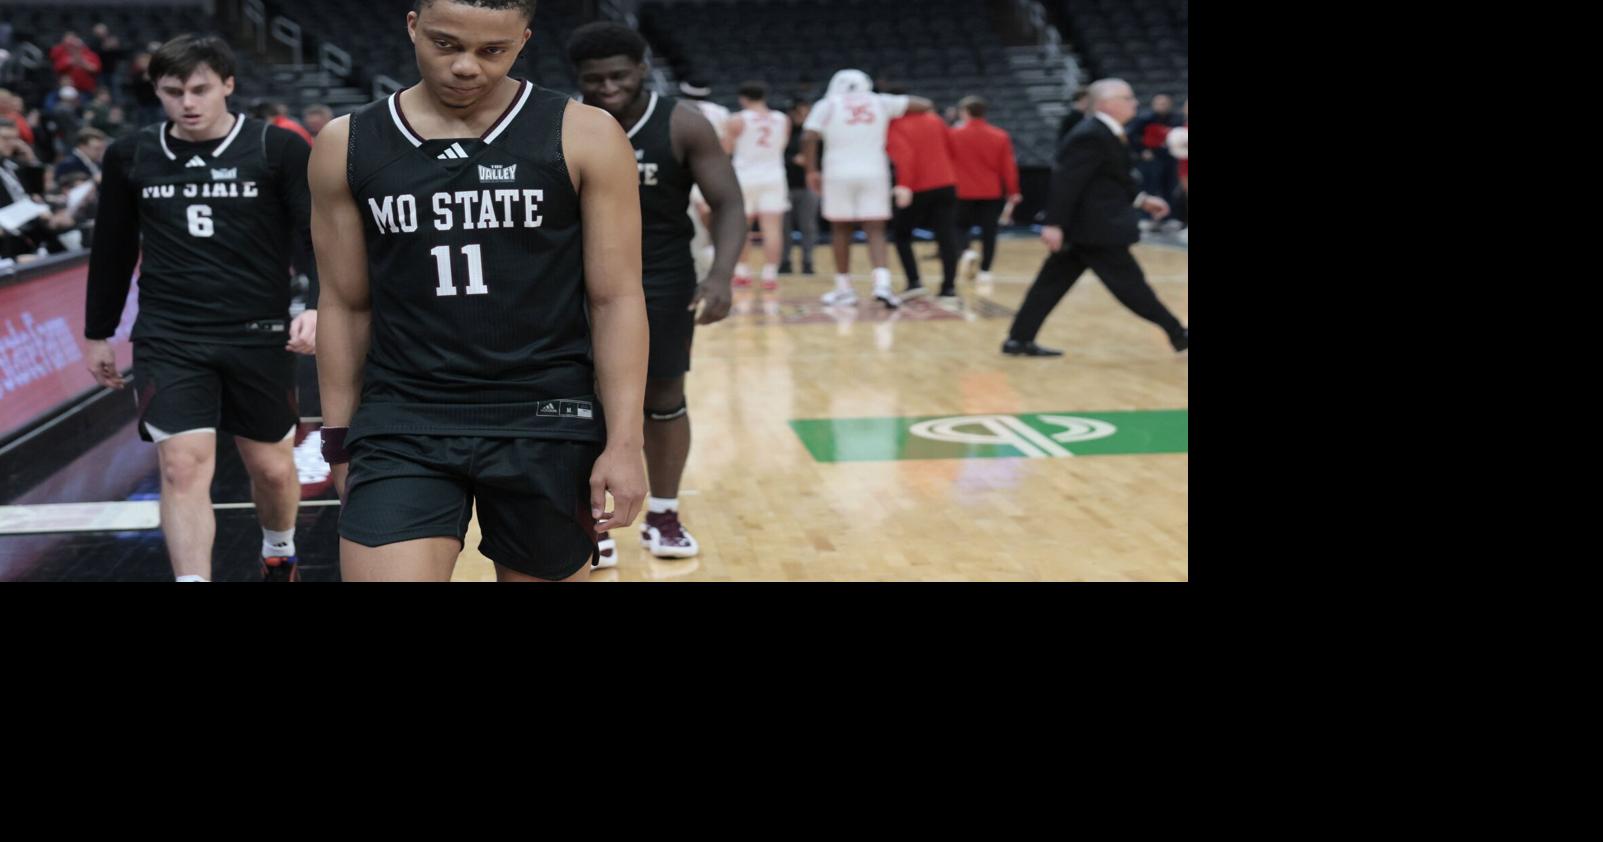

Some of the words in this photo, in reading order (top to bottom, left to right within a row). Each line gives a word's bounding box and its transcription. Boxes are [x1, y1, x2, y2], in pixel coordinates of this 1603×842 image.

[756, 126, 772, 149] 2
[478, 163, 517, 180] VALLEY
[186, 204, 215, 238] 6
[368, 193, 418, 235] MO
[432, 189, 544, 231] STATE
[430, 243, 489, 297] 11
